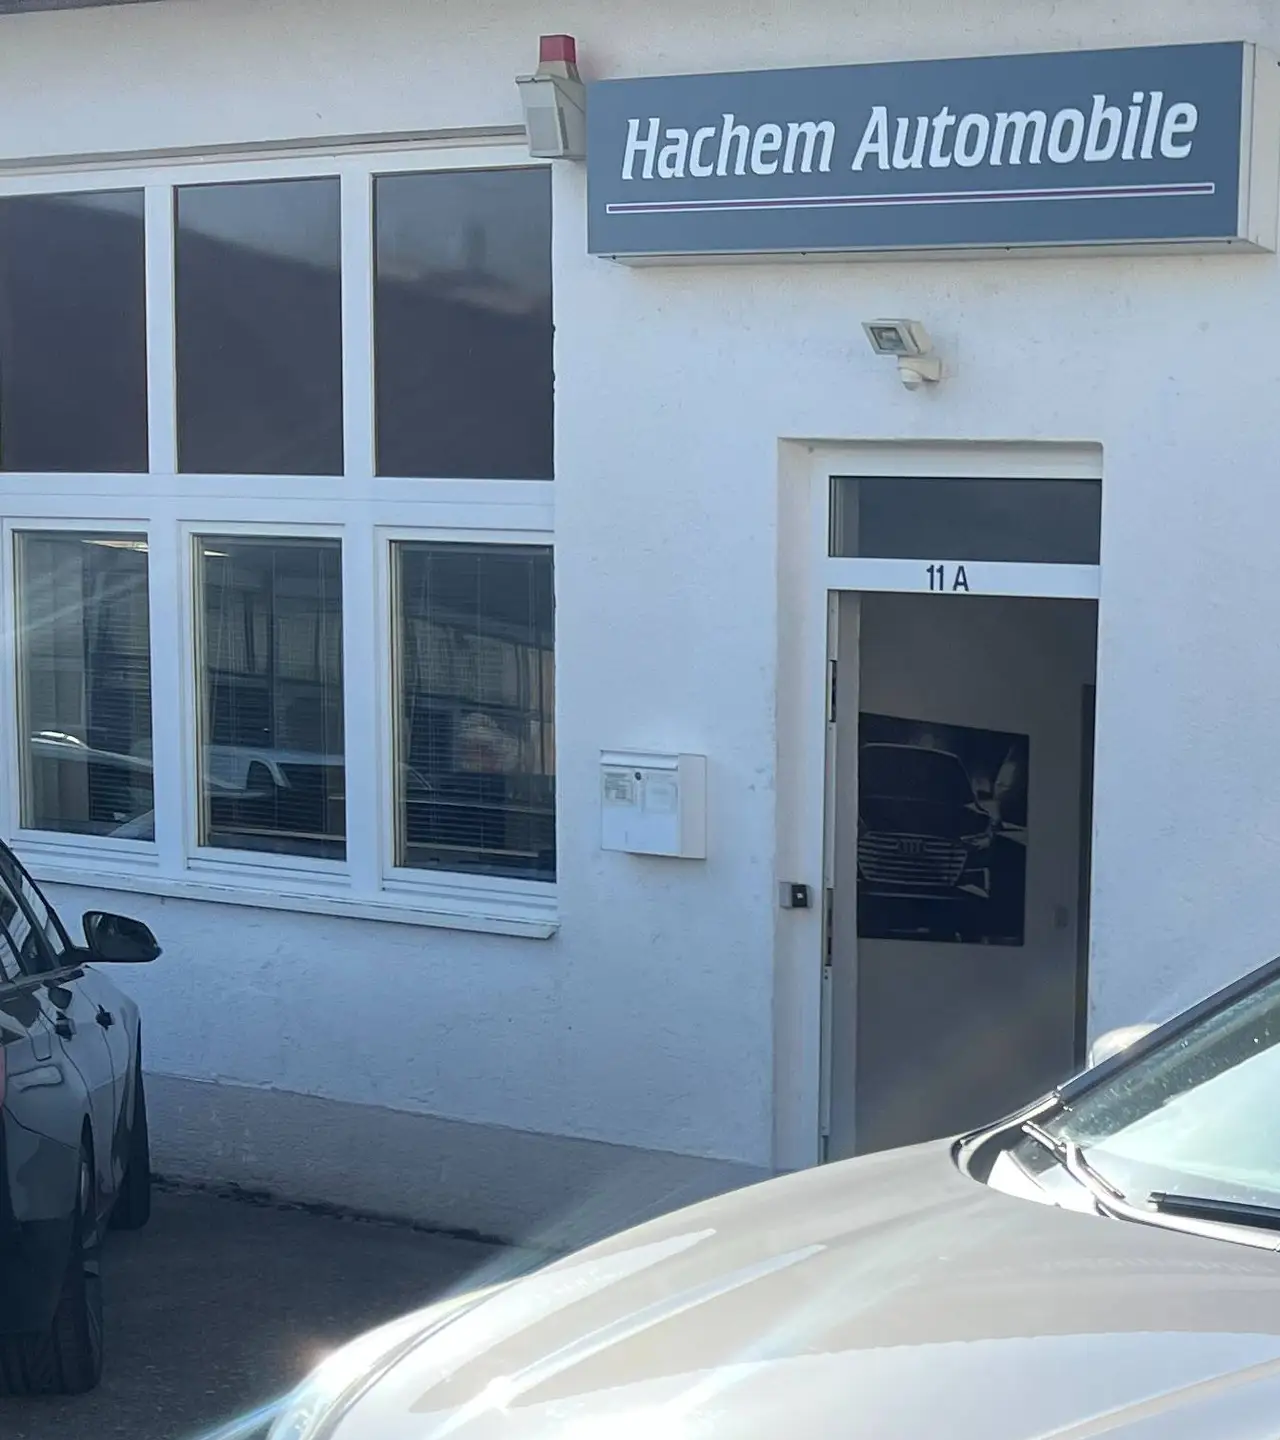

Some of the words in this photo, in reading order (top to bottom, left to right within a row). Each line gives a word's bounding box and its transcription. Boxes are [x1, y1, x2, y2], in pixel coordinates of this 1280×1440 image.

[621, 113, 835, 180] Hachem
[851, 91, 1198, 171] Automobile
[926, 564, 944, 591] 11
[952, 565, 969, 592] A
